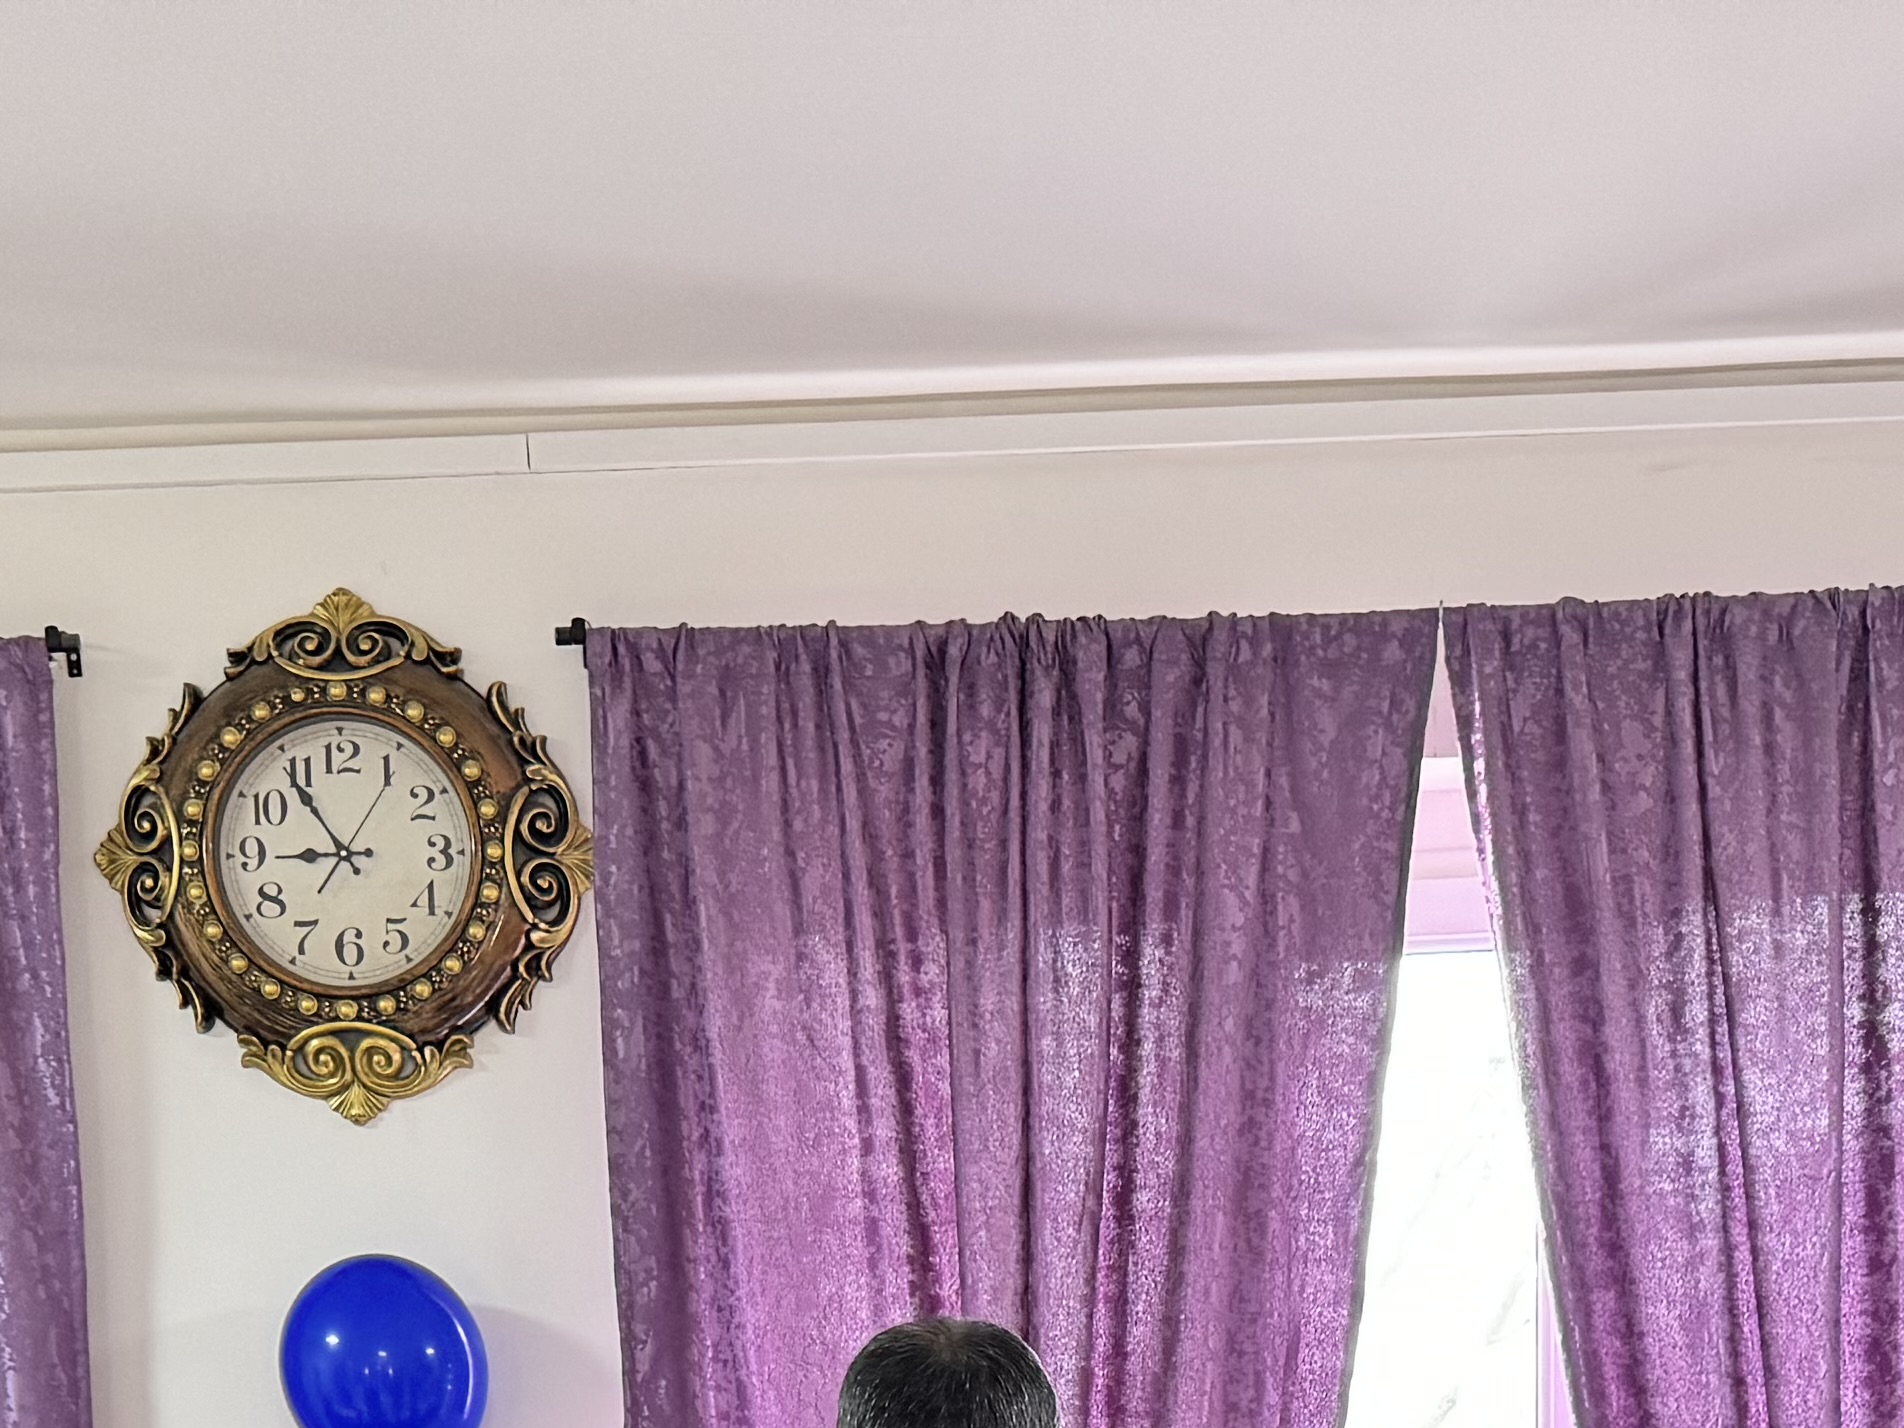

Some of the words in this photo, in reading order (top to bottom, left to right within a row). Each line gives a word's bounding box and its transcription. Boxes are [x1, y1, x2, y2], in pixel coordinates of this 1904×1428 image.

[287, 755, 313, 788] 11
[323, 739, 362, 775] 12
[379, 752, 392, 788] 1
[252, 788, 288, 827] 10
[409, 784, 437, 822] 2
[238, 835, 267, 873] 9
[426, 833, 454, 872] 3
[256, 881, 287, 919] 8
[409, 878, 442, 917] 4
[293, 918, 320, 956] 7
[334, 926, 365, 967] 6
[382, 917, 410, 955] 5
